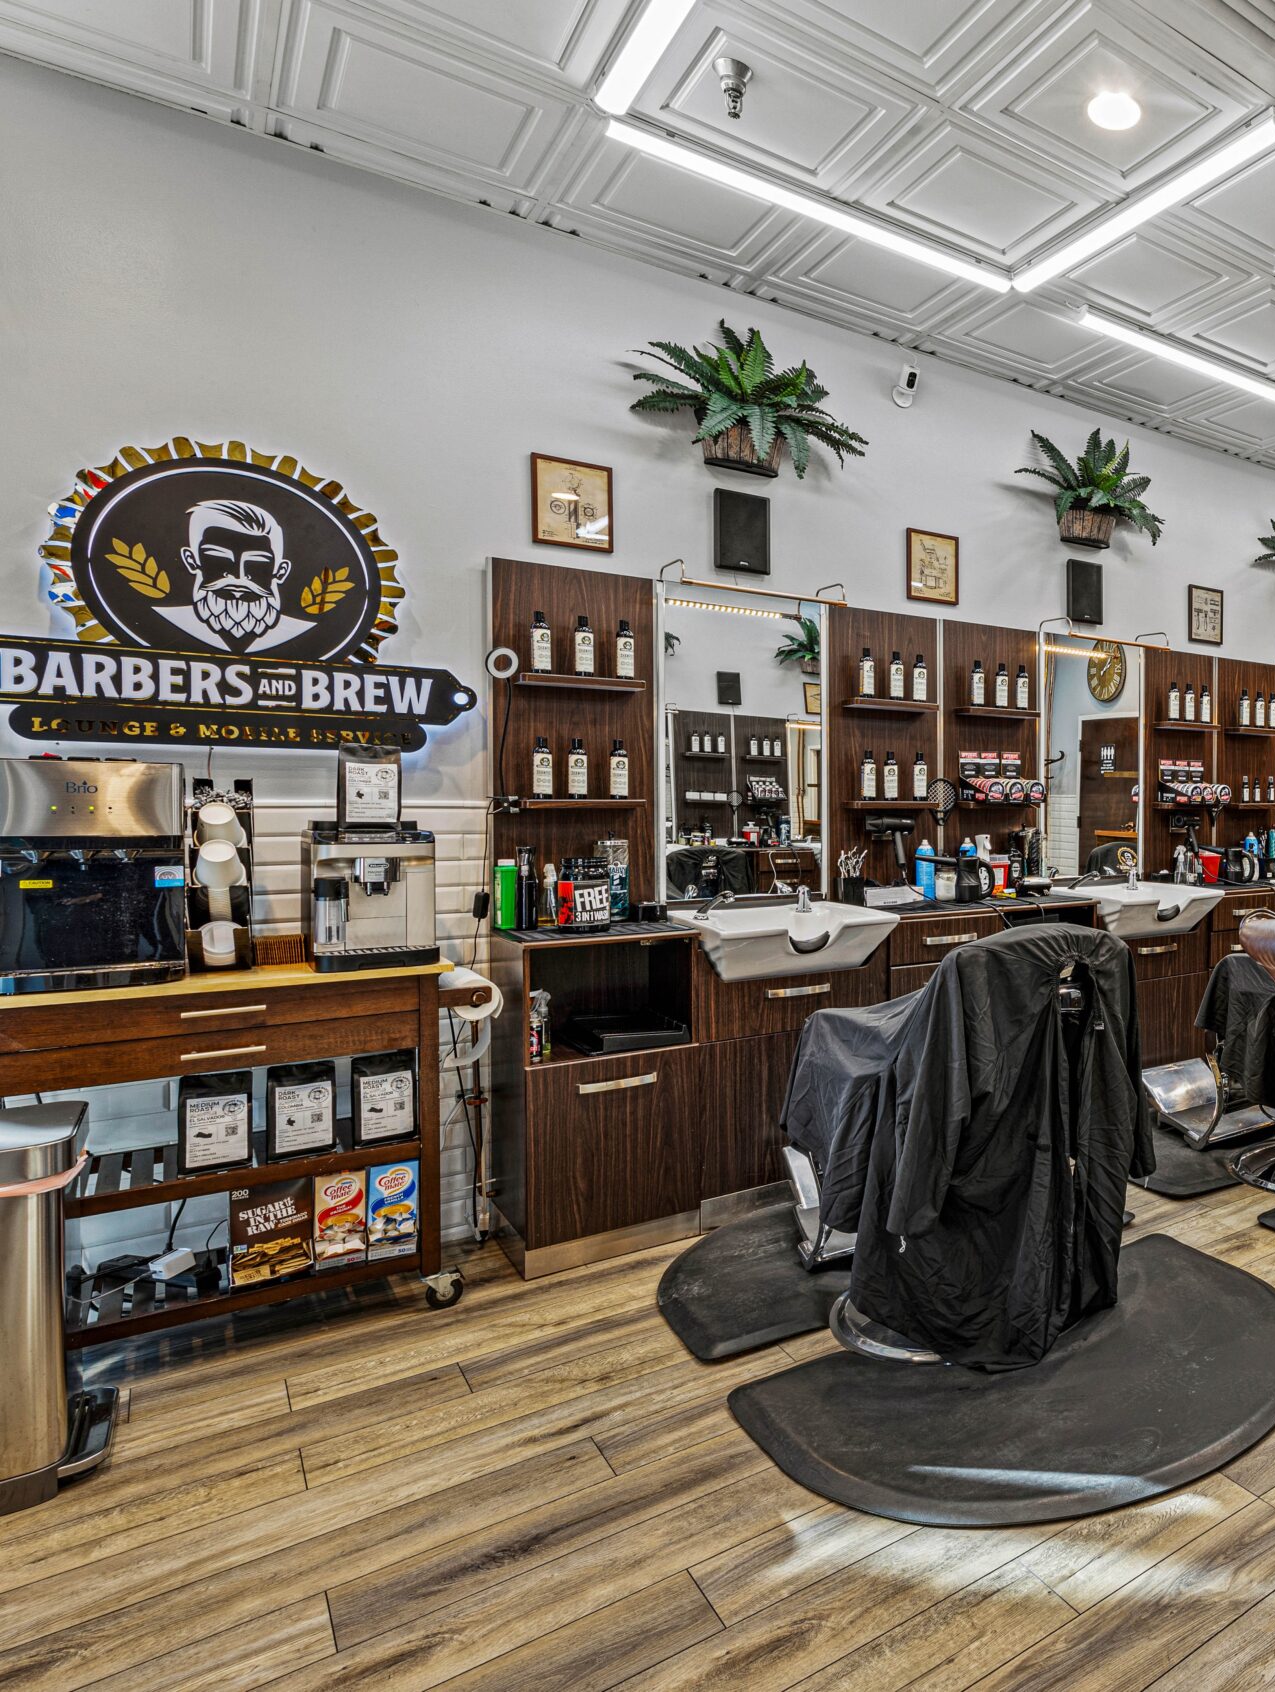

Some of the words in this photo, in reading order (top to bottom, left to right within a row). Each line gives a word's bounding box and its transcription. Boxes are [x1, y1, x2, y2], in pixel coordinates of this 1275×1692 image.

[0, 647, 254, 706] BARBERS
[258, 678, 297, 696] AND
[301, 668, 434, 715] BREW
[31, 716, 160, 736] LOUNGE
[169, 722, 187, 738] &
[198, 723, 301, 742] MOBILE
[310, 728, 413, 745] SERVICE
[66, 780, 98, 794] Brio
[574, 885, 609, 912] FREE
[575, 912, 582, 922] 3
[582, 911, 590, 921] IN
[190, 1101, 220, 1109] MEDIUM
[378, 1174, 406, 1187] Coffee
[385, 1180, 405, 1191] mate
[231, 1189, 249, 1198] 200
[324, 1183, 353, 1197] Coffee
[331, 1190, 351, 1200] mate
[238, 1200, 285, 1221] SUGAR
[249, 1215, 265, 1227] IN
[266, 1205, 296, 1221] THE
[246, 1219, 277, 1236] RAW
